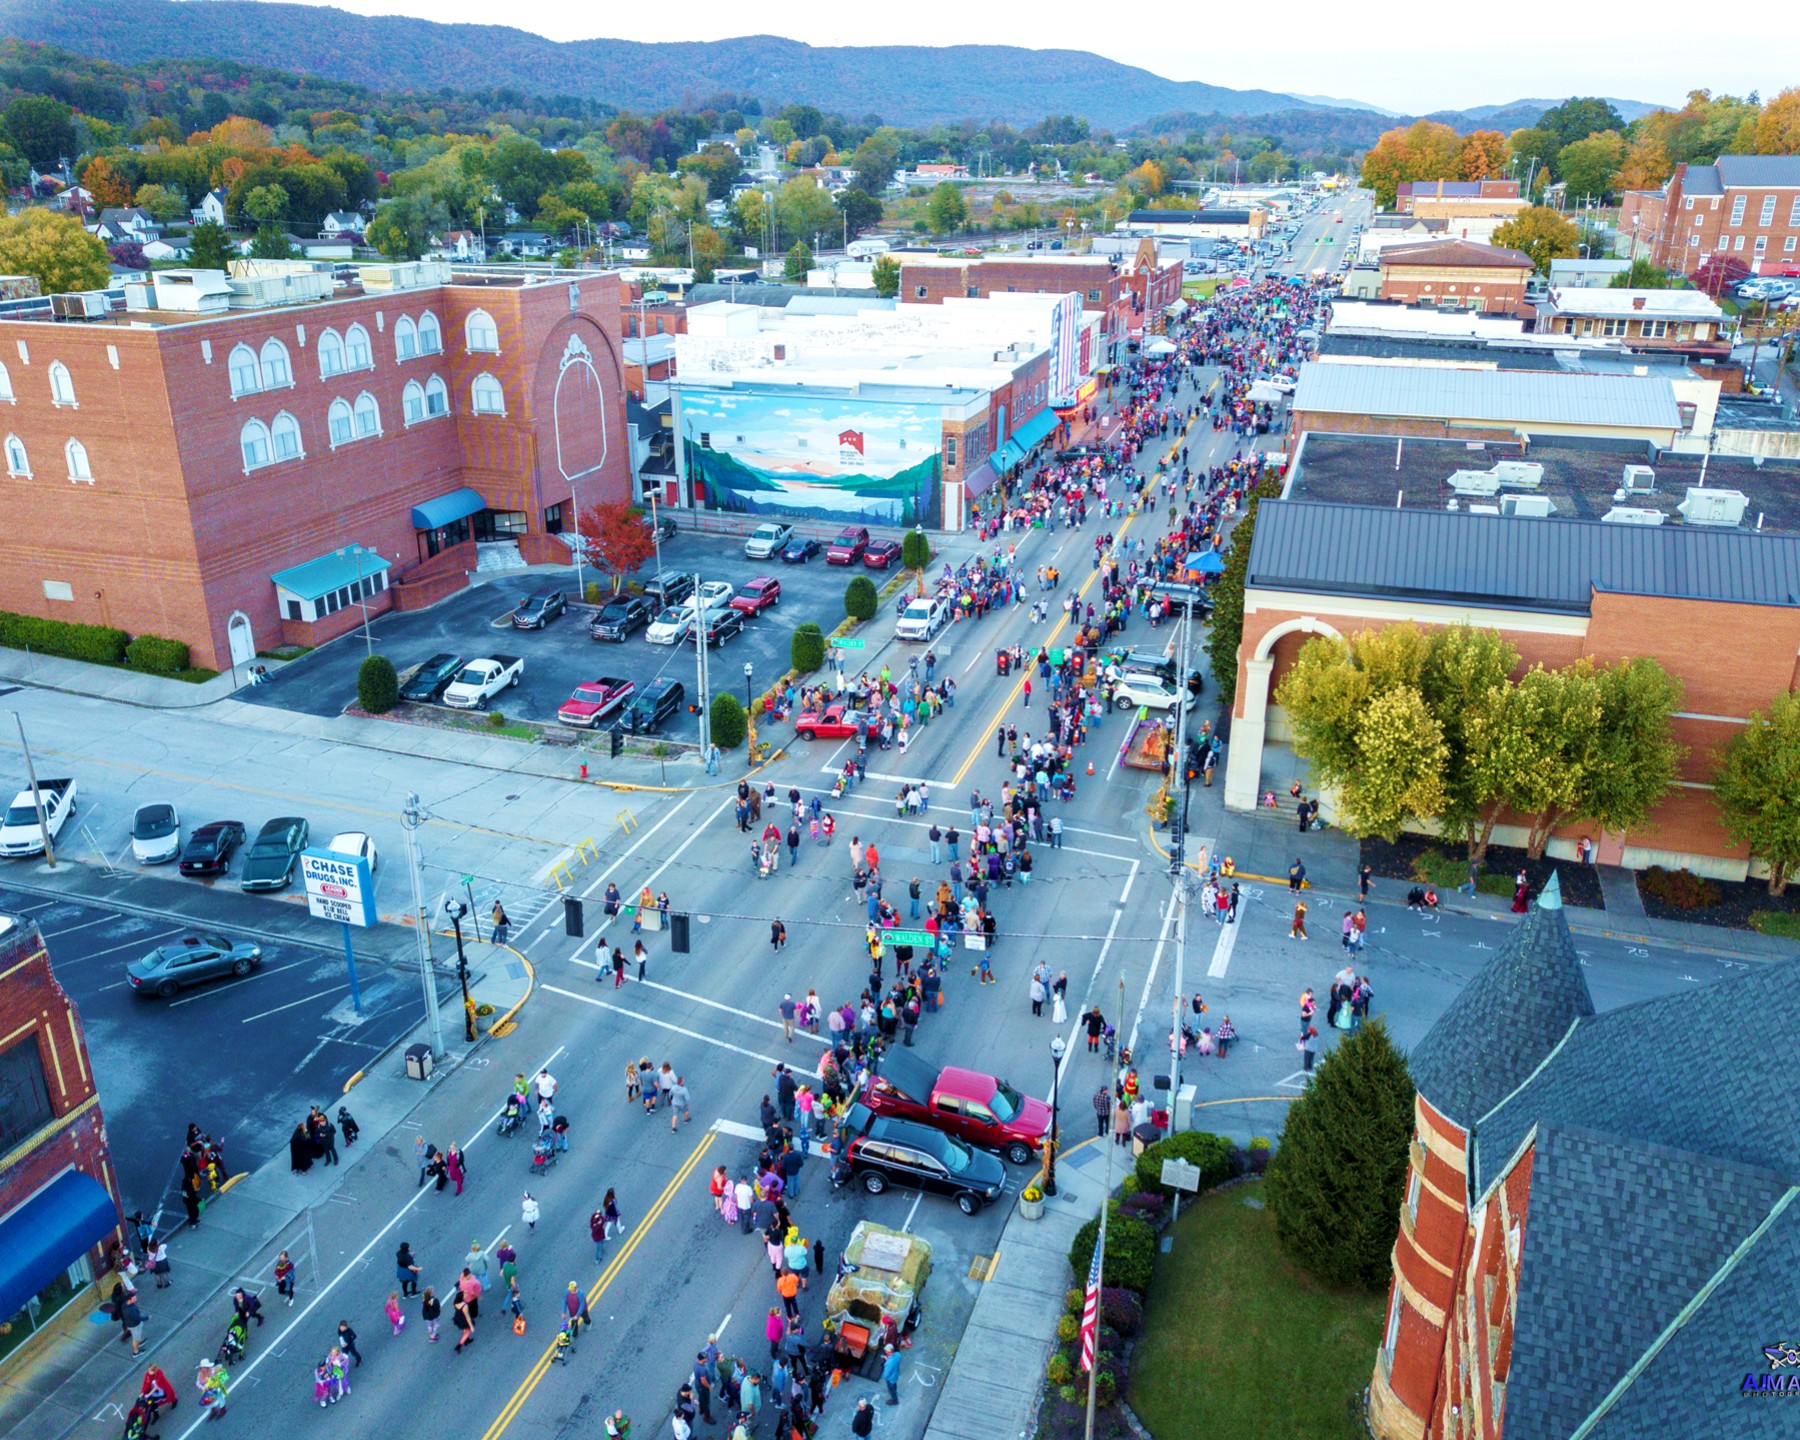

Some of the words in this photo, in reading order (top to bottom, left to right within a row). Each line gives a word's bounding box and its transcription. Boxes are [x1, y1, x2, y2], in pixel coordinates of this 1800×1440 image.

[311, 860, 354, 877] CHASE
[330, 900, 352, 910] SCOOPED
[333, 914, 351, 922] CREAM
[895, 934, 923, 944] WALDEN
[924, 936, 933, 945] ST
